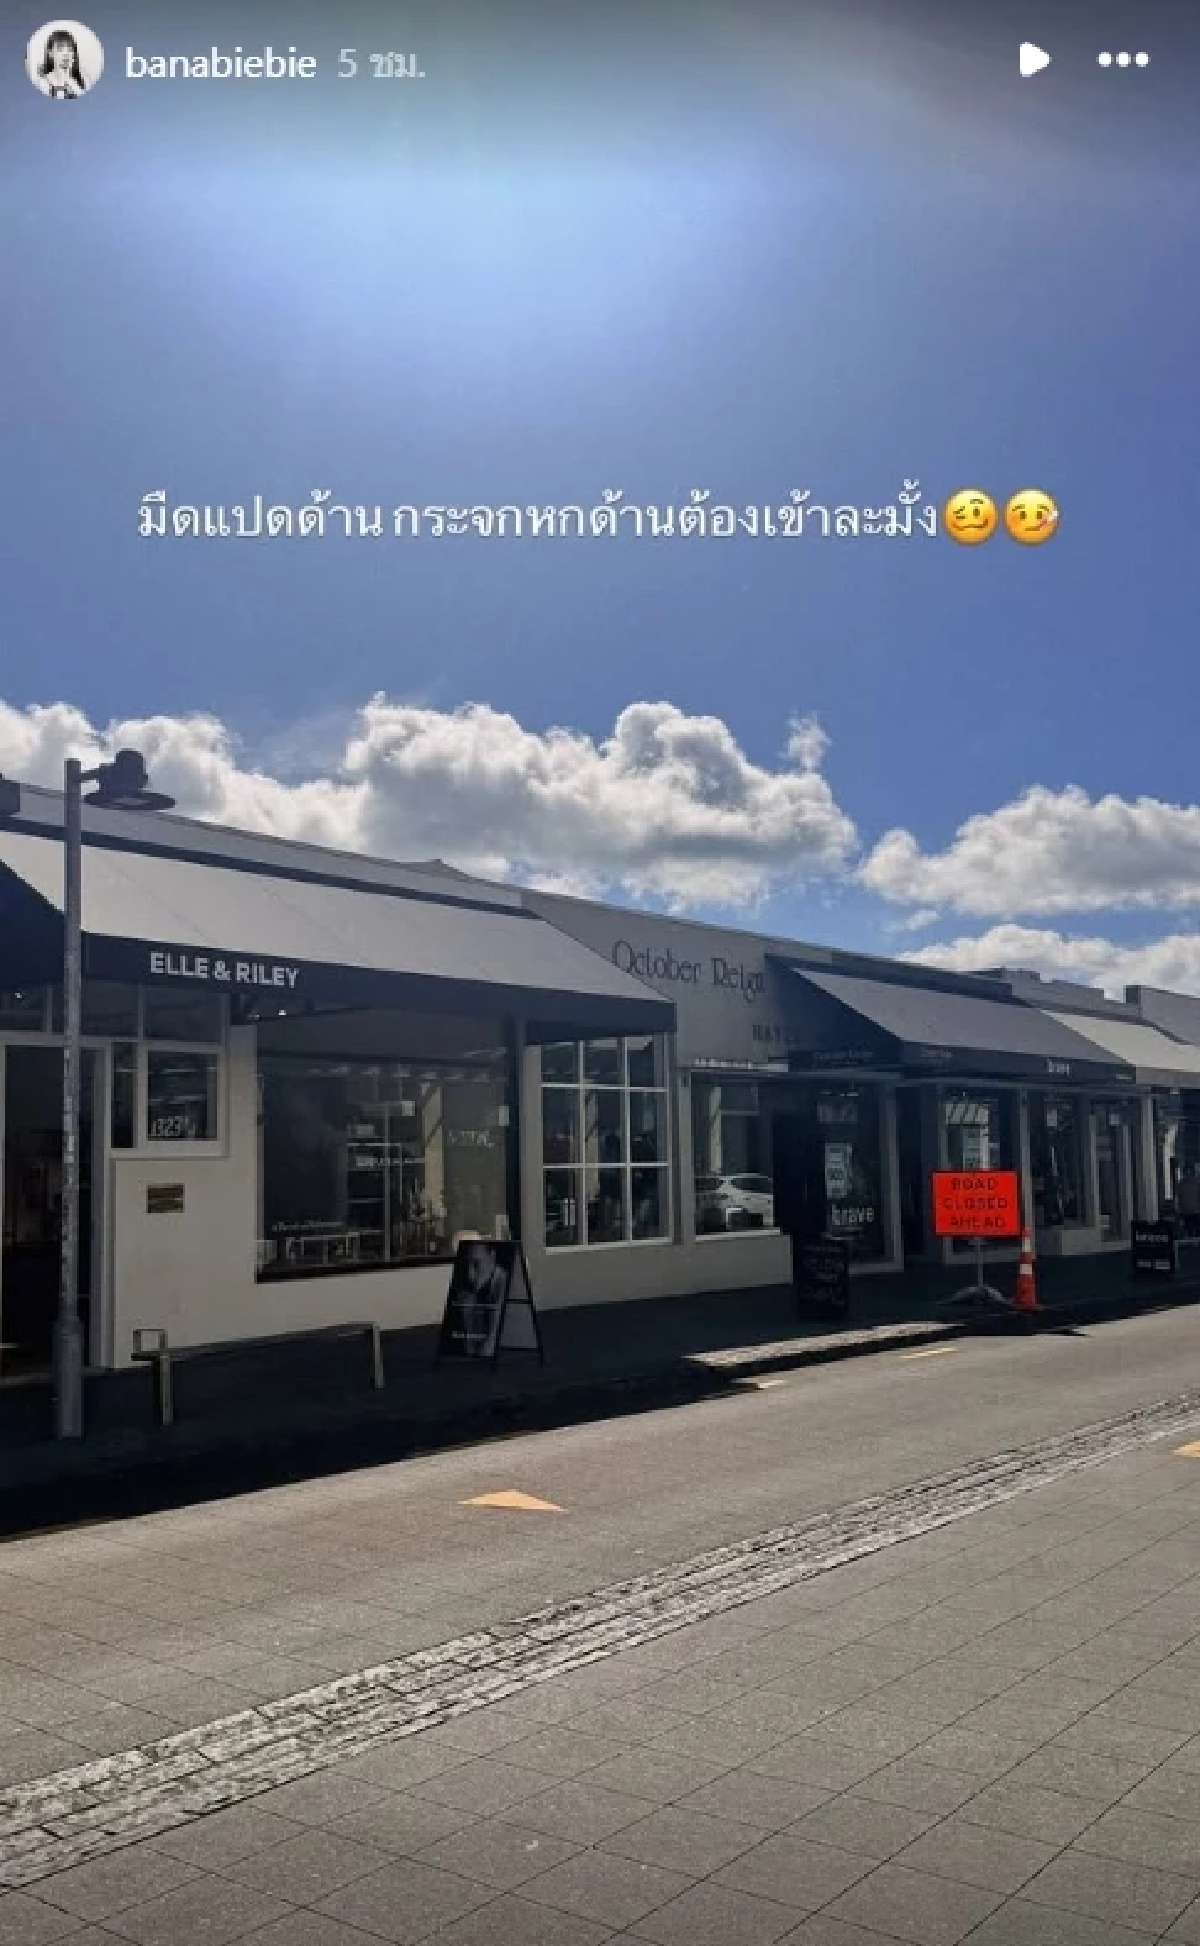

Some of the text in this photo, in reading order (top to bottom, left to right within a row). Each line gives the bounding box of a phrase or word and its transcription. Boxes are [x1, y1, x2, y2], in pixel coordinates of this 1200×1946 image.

[149, 952, 300, 989] ELLE & RILEY
[612, 940, 765, 1003] October Reign
[950, 1177, 998, 1191] ROAD
[942, 1197, 1008, 1210] CLOSED
[947, 1215, 1006, 1229] AHEAD
